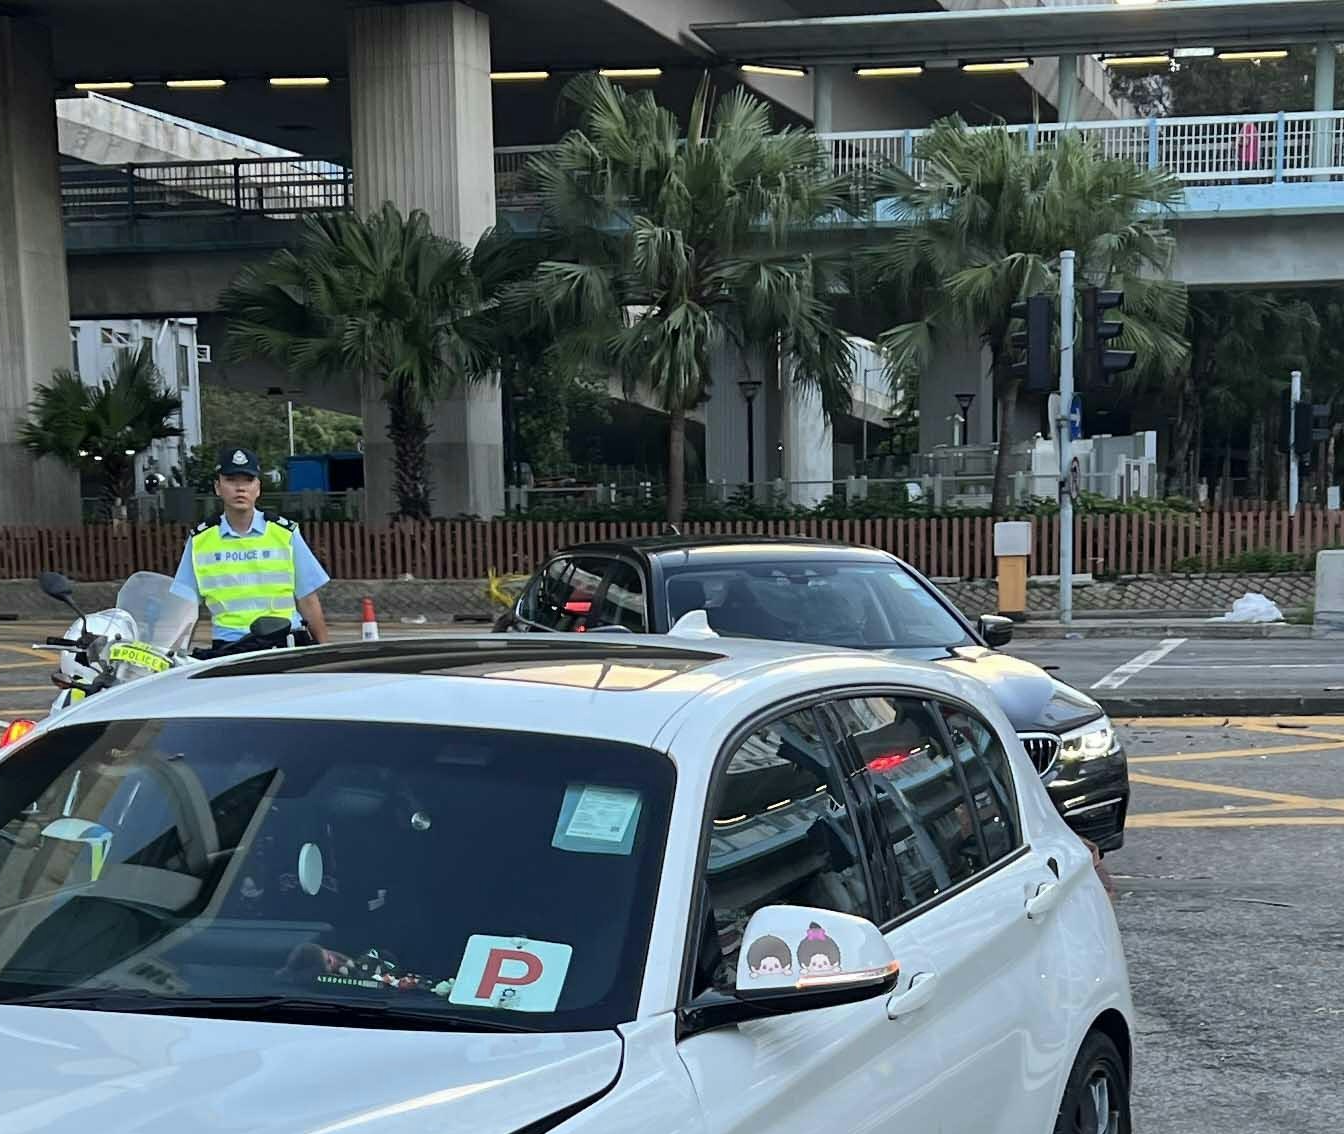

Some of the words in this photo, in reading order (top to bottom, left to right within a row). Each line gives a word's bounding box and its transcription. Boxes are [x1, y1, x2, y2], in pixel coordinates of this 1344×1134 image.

[225, 551, 258, 561] POLICE
[121, 650, 161, 668] POLICE
[475, 948, 544, 999] P
